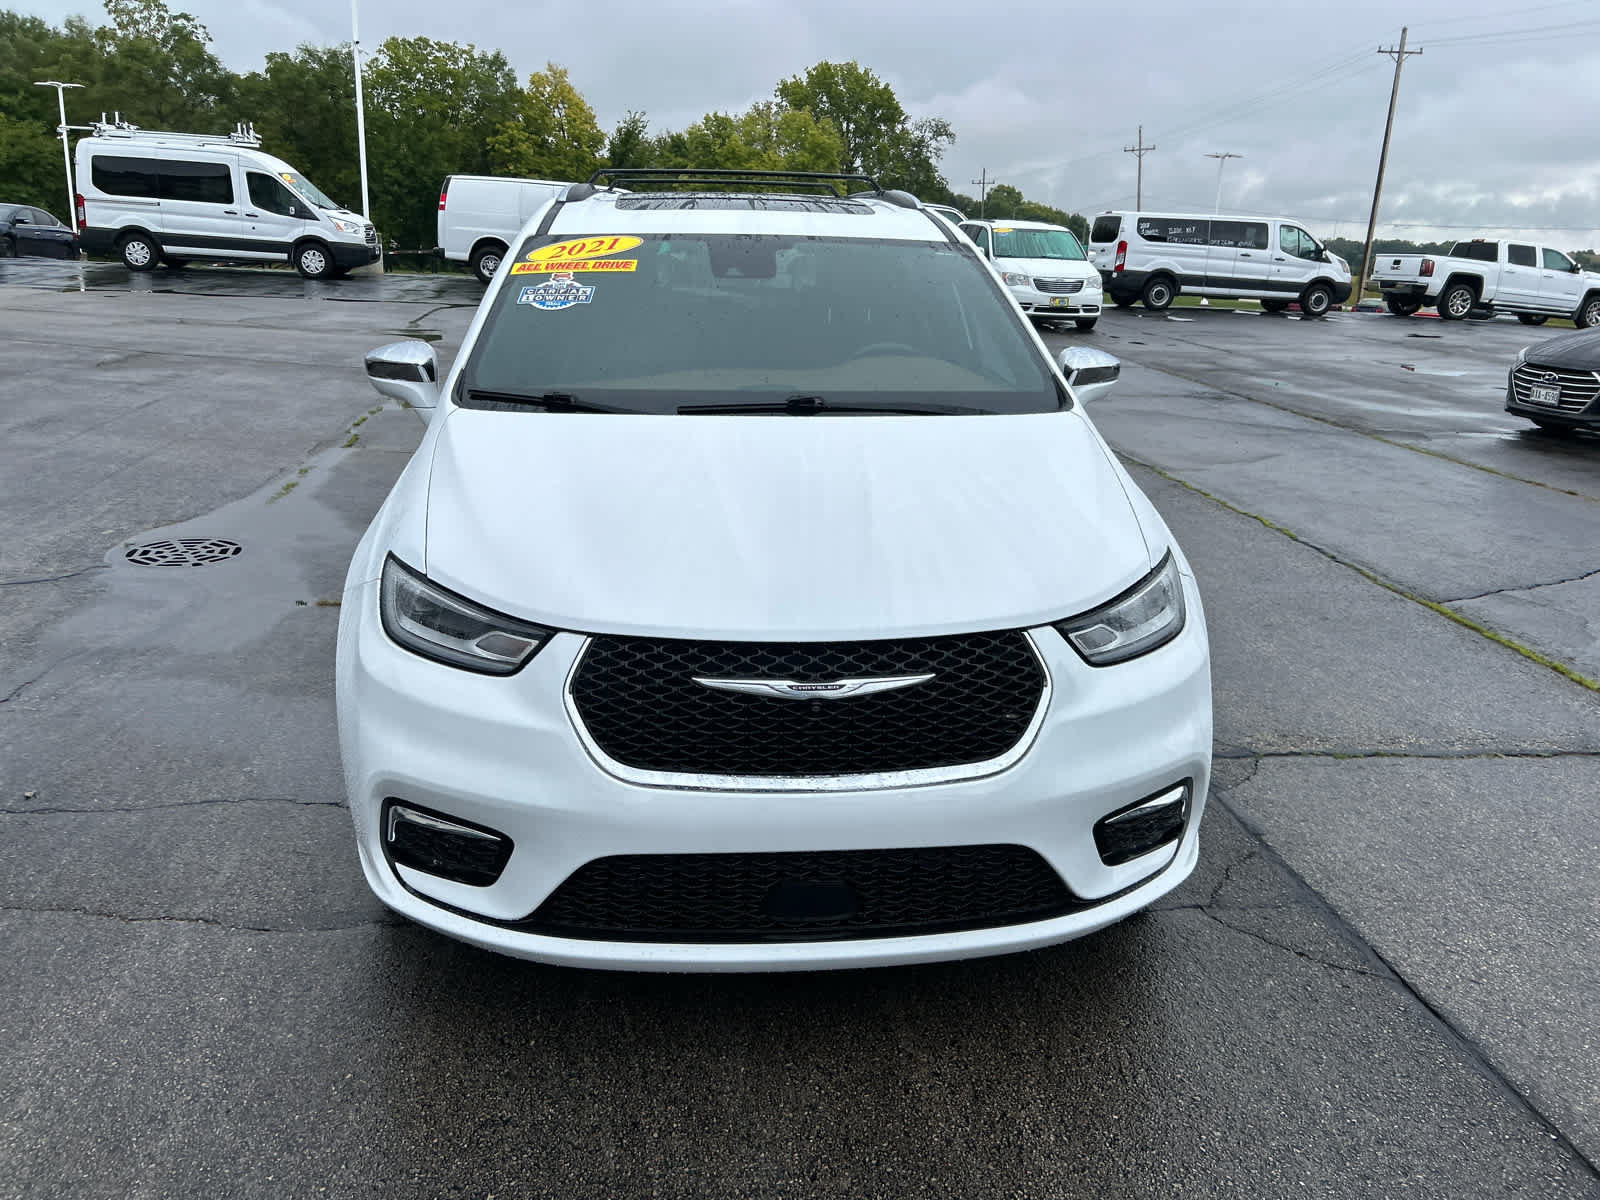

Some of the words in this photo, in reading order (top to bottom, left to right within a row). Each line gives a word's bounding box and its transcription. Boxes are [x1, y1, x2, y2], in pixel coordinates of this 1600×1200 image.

[547, 238, 620, 260] 2021
[516, 263, 542, 272] ALL
[544, 261, 590, 271] WHEEL
[592, 260, 634, 270] DRIVE
[526, 287, 591, 295] CARFAX
